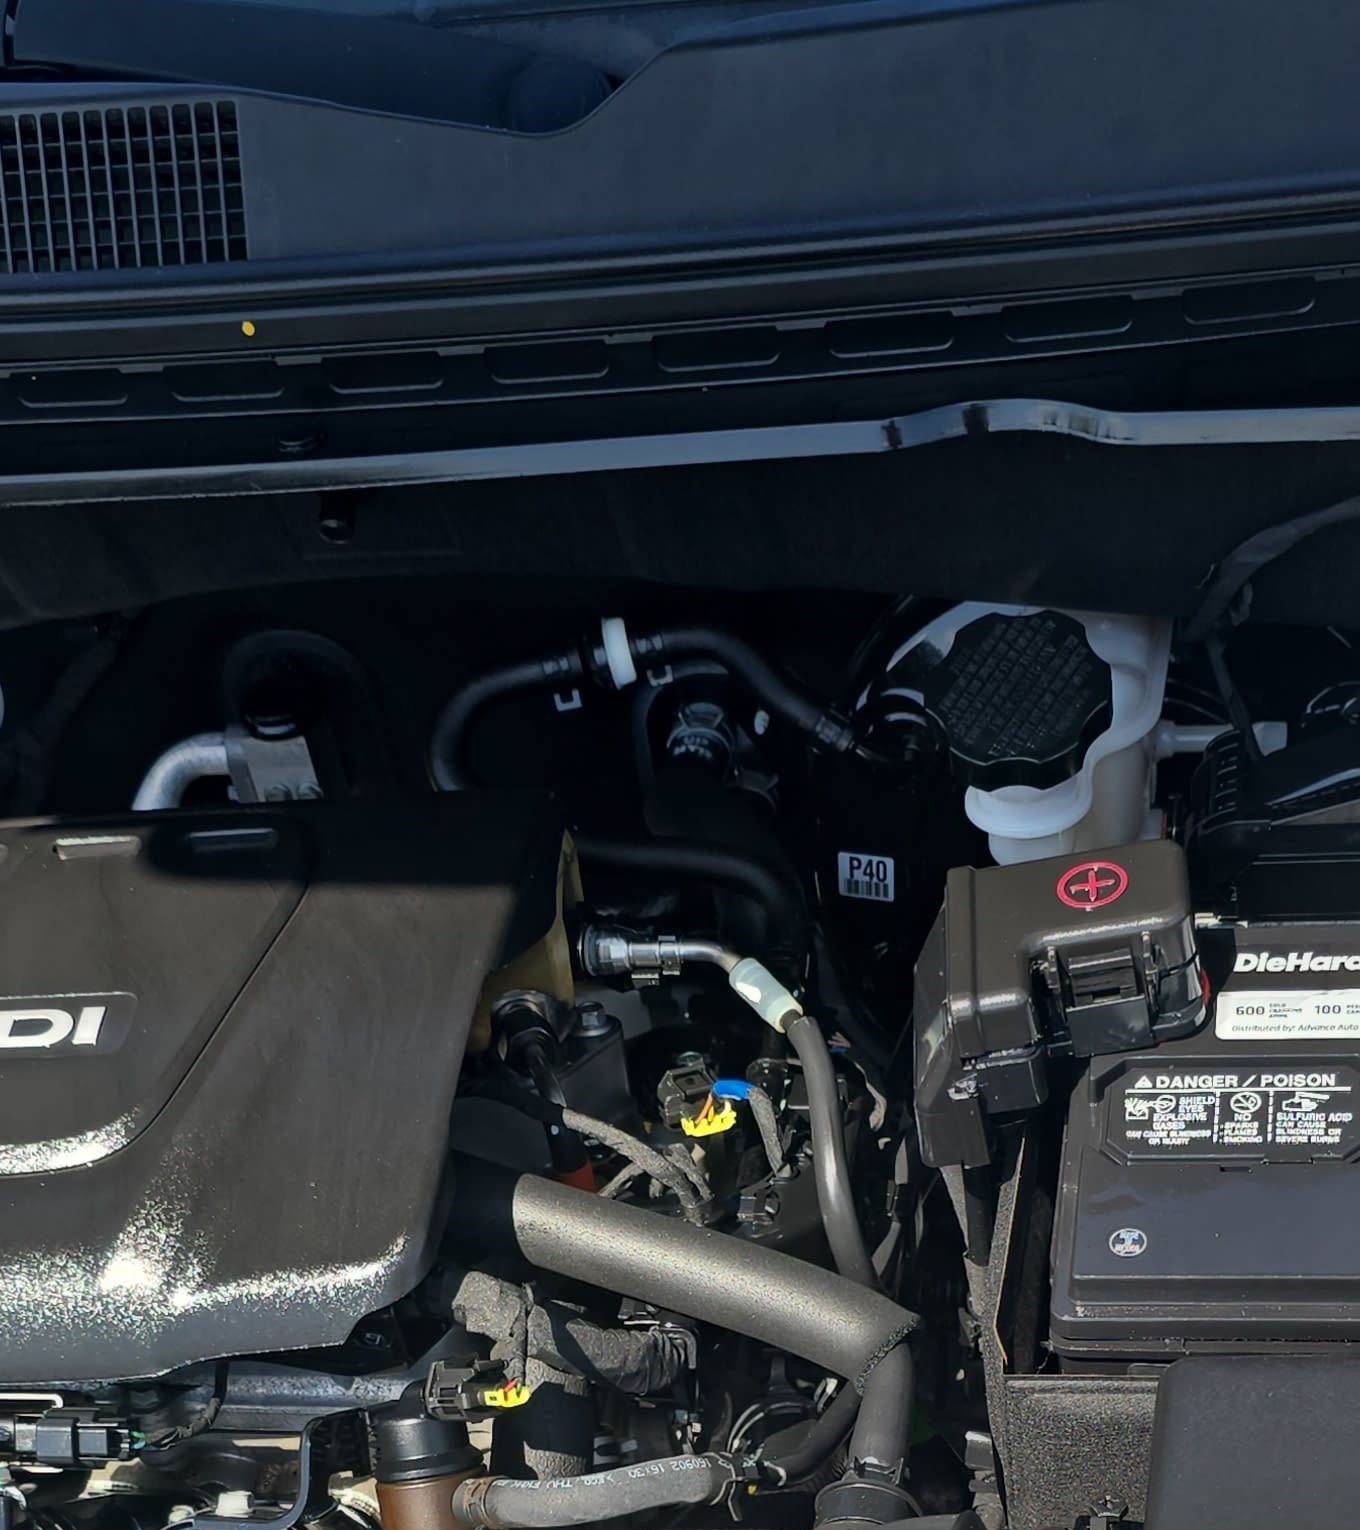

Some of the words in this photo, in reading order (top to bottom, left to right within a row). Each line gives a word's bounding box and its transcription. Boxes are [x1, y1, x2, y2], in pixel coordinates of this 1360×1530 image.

[849, 856, 887, 882] P40
[1236, 1006, 1265, 1015] 600
[1314, 1004, 1342, 1014] 100
[1298, 1023, 1336, 1032] Advance
[1337, 1023, 1359, 1031] Auto
[1156, 1075, 1238, 1088] DANGER
[1260, 1074, 1336, 1087] POISON
[1179, 1096, 1215, 1105] SHIELD
[1178, 1105, 1204, 1113] EYES
[1153, 1112, 1207, 1121] EXPLOSIVE
[1234, 1113, 1252, 1122] NO
[1276, 1112, 1326, 1121] SULFURIC
[1328, 1113, 1353, 1122] ACID
[1153, 1121, 1186, 1130] GASES
